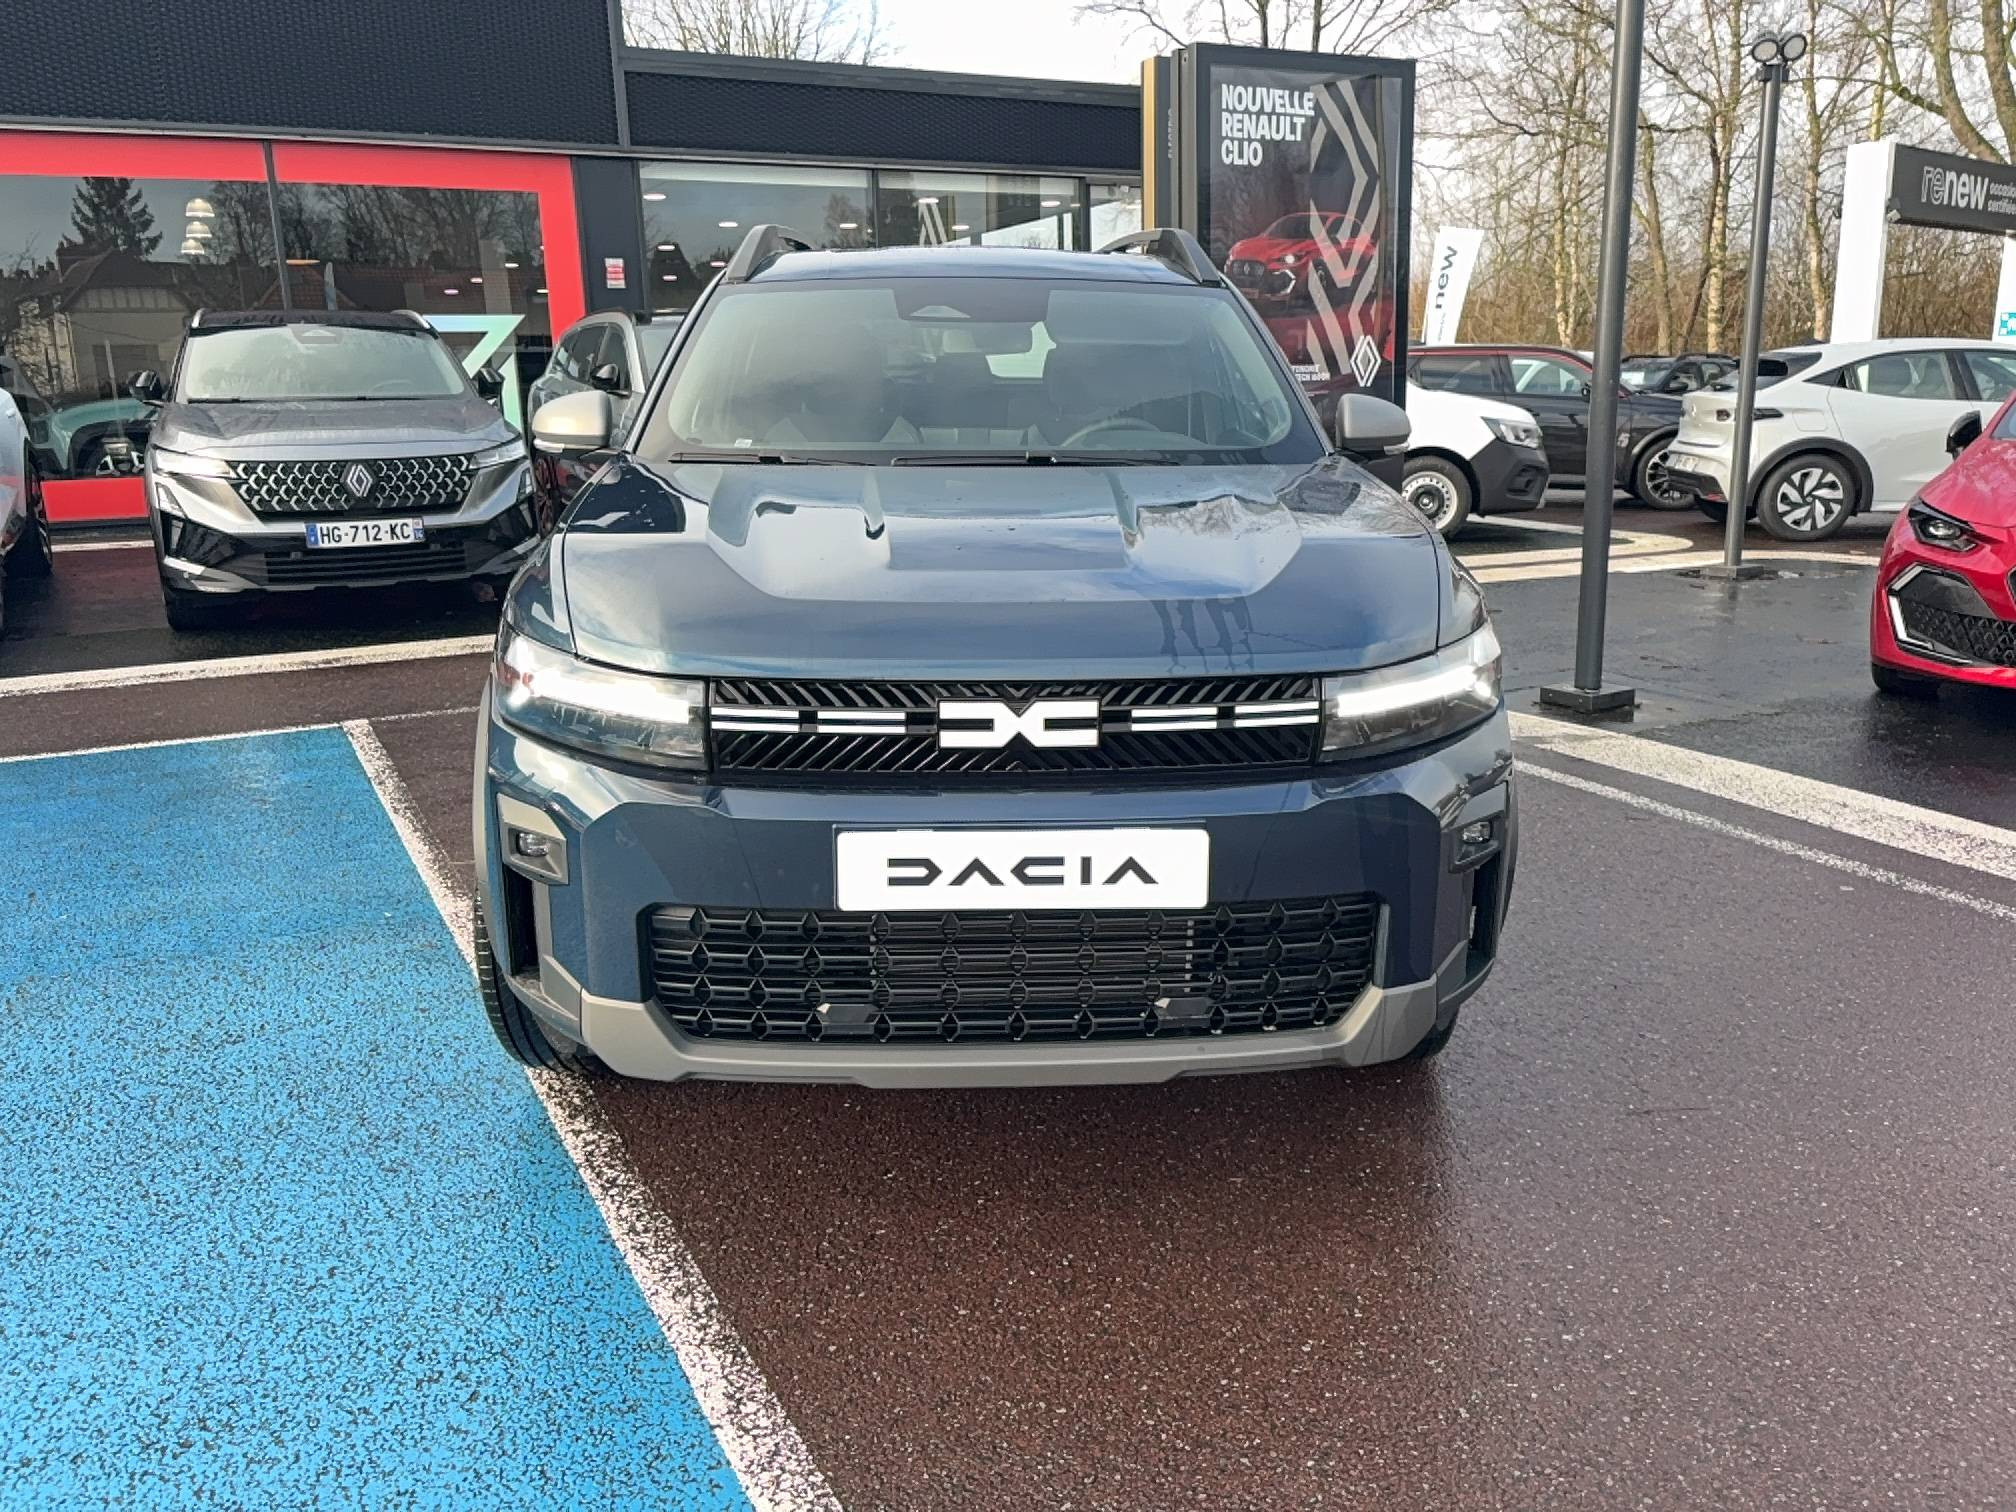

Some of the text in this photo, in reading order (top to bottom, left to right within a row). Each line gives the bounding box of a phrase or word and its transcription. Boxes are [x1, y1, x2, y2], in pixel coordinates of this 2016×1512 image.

[1221, 84, 1315, 117] NOUVELLE
[1221, 113, 1305, 142] RENAULT
[1221, 139, 1263, 167] CLIO
[1921, 166, 1989, 211] renew
[1435, 246, 1458, 309] new
[319, 523, 411, 544] HG-712-KC
[887, 856, 1159, 887] DACIA
